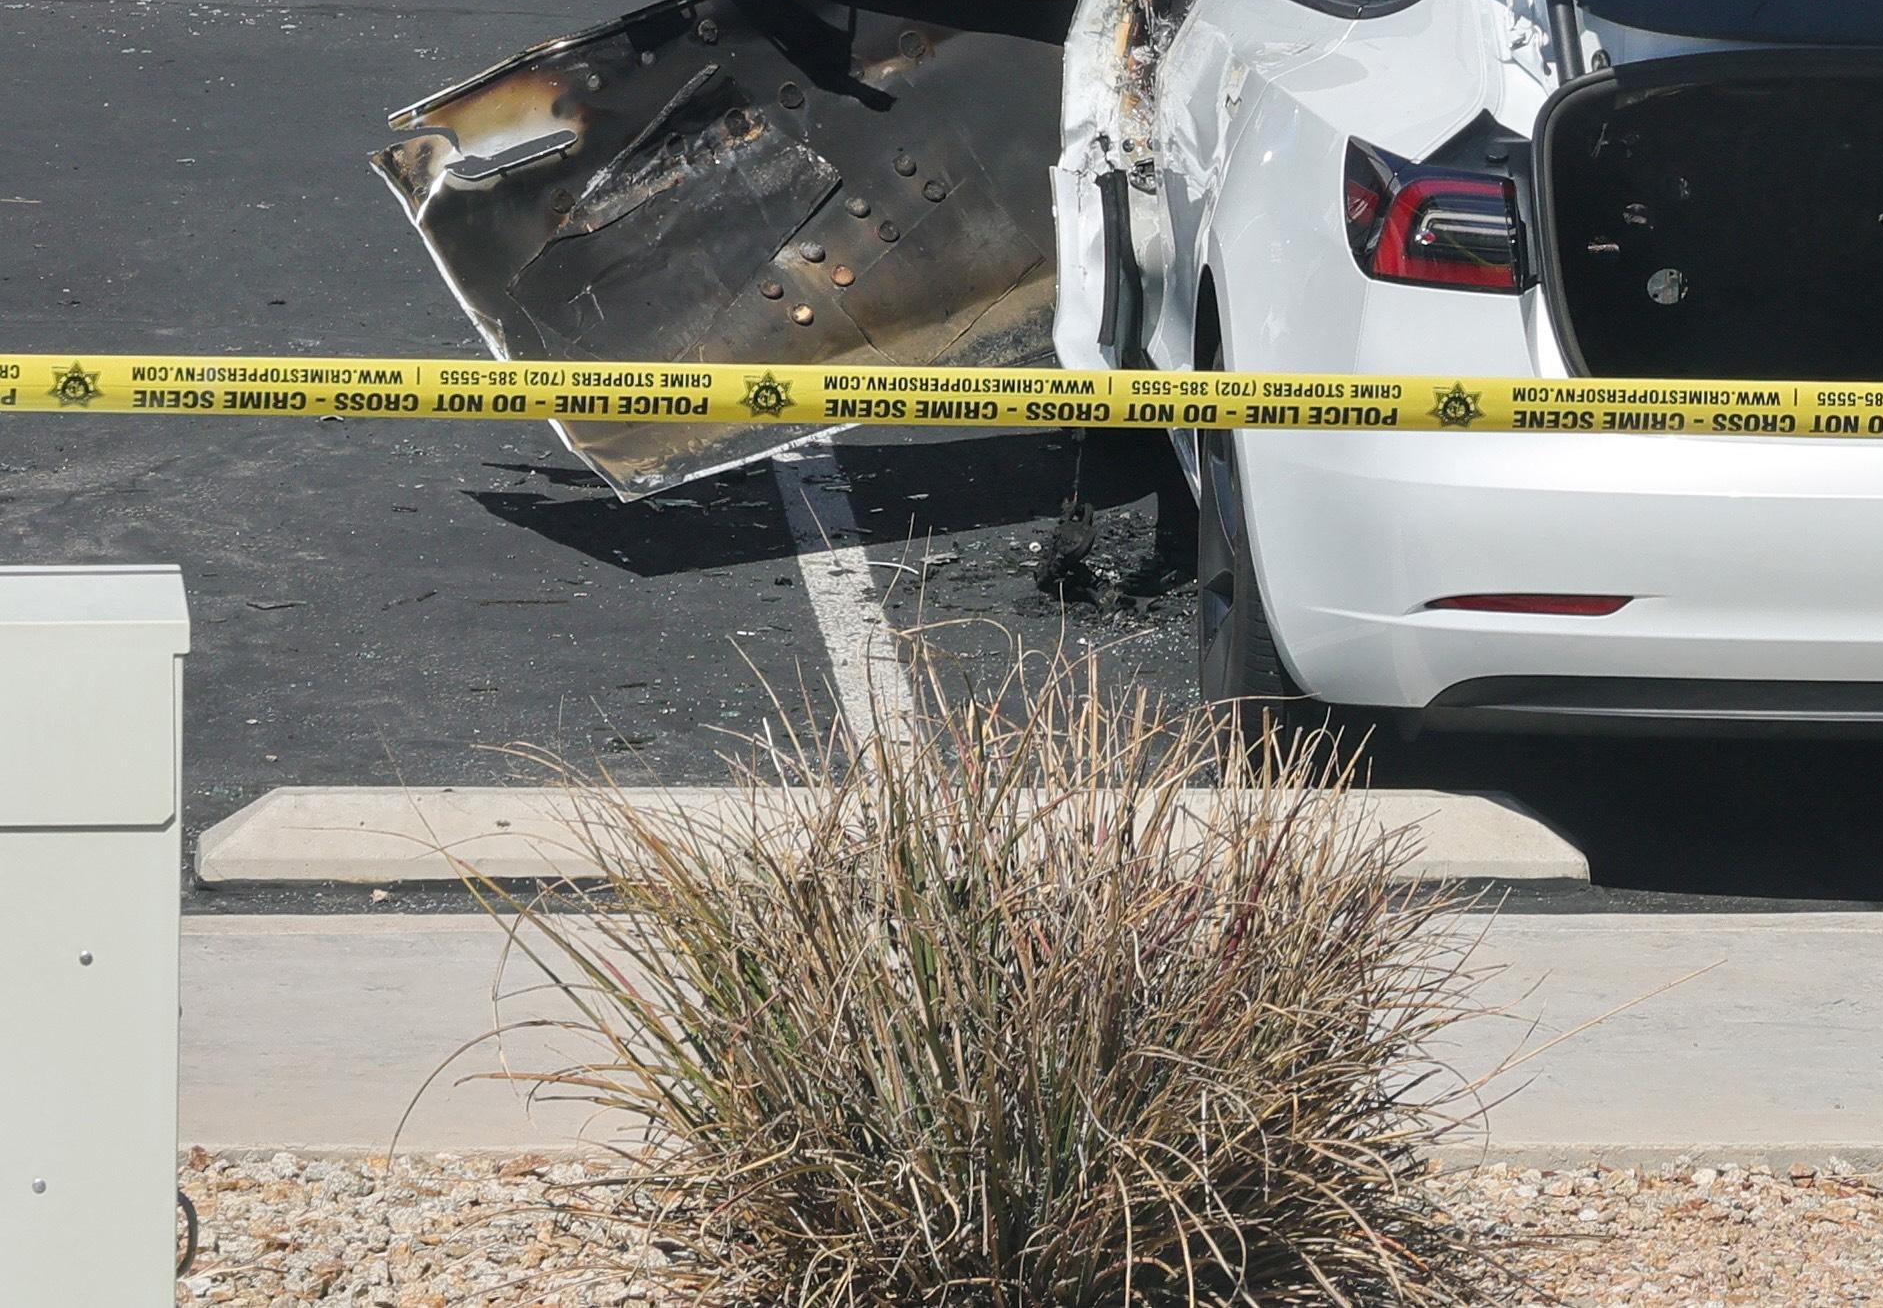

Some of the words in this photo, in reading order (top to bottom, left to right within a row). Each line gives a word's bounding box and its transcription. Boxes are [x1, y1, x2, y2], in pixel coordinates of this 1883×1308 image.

[132, 366, 403, 385] WWW.CRIMESTOPPERSOFNV.COM
[440, 370, 518, 386] 385-5555
[524, 369, 566, 386] (702)
[571, 371, 654, 388] STOPPERS
[660, 373, 712, 389] CRIME
[823, 375, 1095, 395] WWW.CRIMESTOPPERSOFNV.COM
[1131, 380, 1209, 396] 385-5555
[1215, 379, 1257, 397] (702)
[1262, 382, 1345, 399] STOPPERS
[1350, 384, 1402, 400] CRIME
[1512, 387, 1781, 406] WWW.CRIMESTOPPERSOFNV.COM
[132, 389, 215, 409] SCENE
[222, 390, 307, 411] CRIME
[334, 392, 419, 412] CROSS
[431, 393, 484, 413] NOT
[492, 394, 527, 413] DO
[554, 395, 610, 415] LINE
[617, 395, 709, 416] POLICE
[823, 398, 907, 419] SCENE
[914, 400, 999, 420] CRIME
[1025, 401, 1111, 422] CROSS
[1123, 403, 1175, 423] NOT
[1183, 404, 1218, 424] DO
[1244, 405, 1300, 425] LINE
[1307, 406, 1398, 426] POLICE
[1512, 410, 1595, 430] SCENE
[1602, 411, 1685, 431] CRIME
[1711, 413, 1796, 433] CROSS
[1808, 414, 1860, 434] NOT
